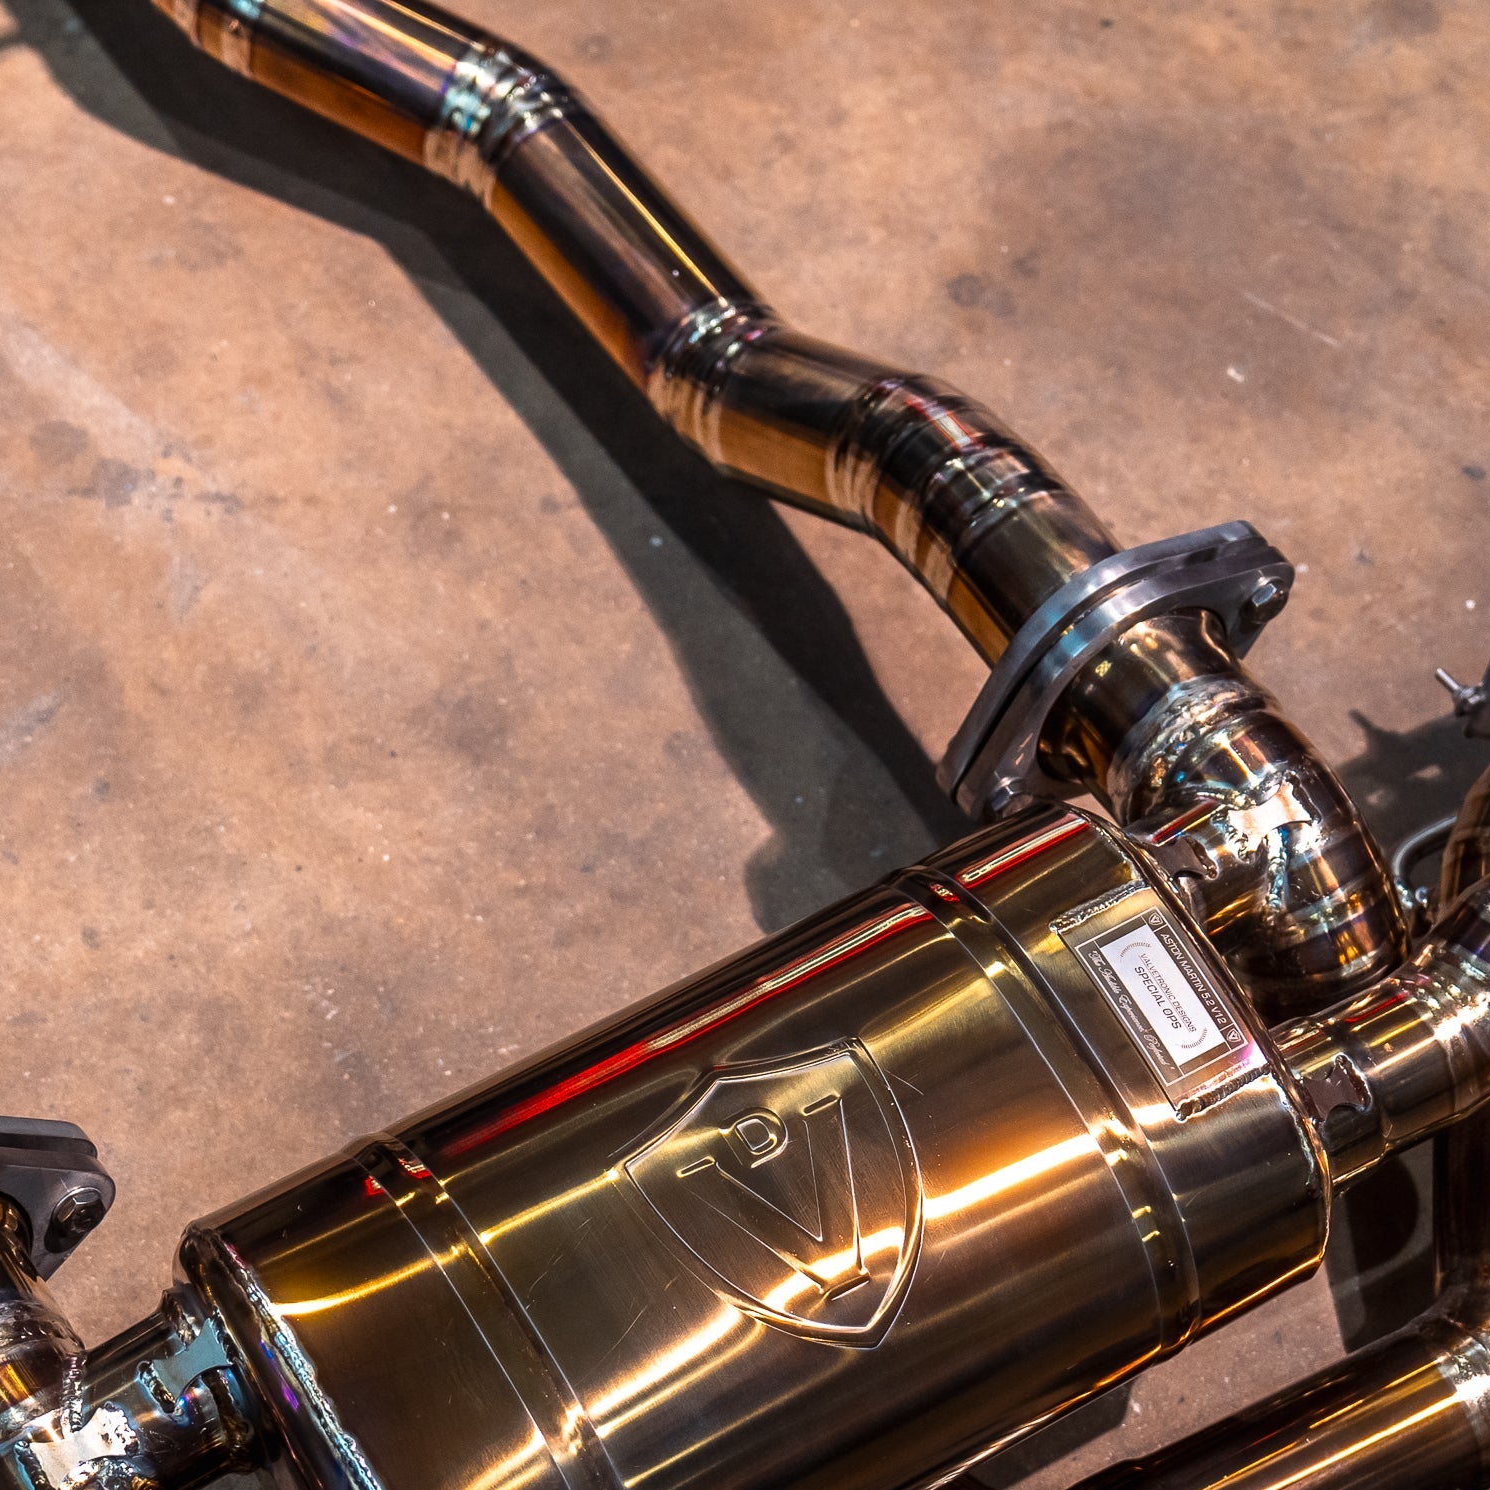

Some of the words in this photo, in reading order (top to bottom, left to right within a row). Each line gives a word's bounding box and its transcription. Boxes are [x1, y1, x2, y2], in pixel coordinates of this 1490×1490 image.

[1134, 966, 1166, 1007] SPECIAL
[1162, 1008, 1182, 1030] OPS
[1139, 953, 1176, 1001] VALVETRONIC
[1173, 999, 1197, 1033] DESIGNS
[1161, 933, 1184, 960] ASTON
[1178, 960, 1204, 992] MARTIN
[1201, 992, 1215, 1007] 5.2
[1211, 1004, 1227, 1025] V12
